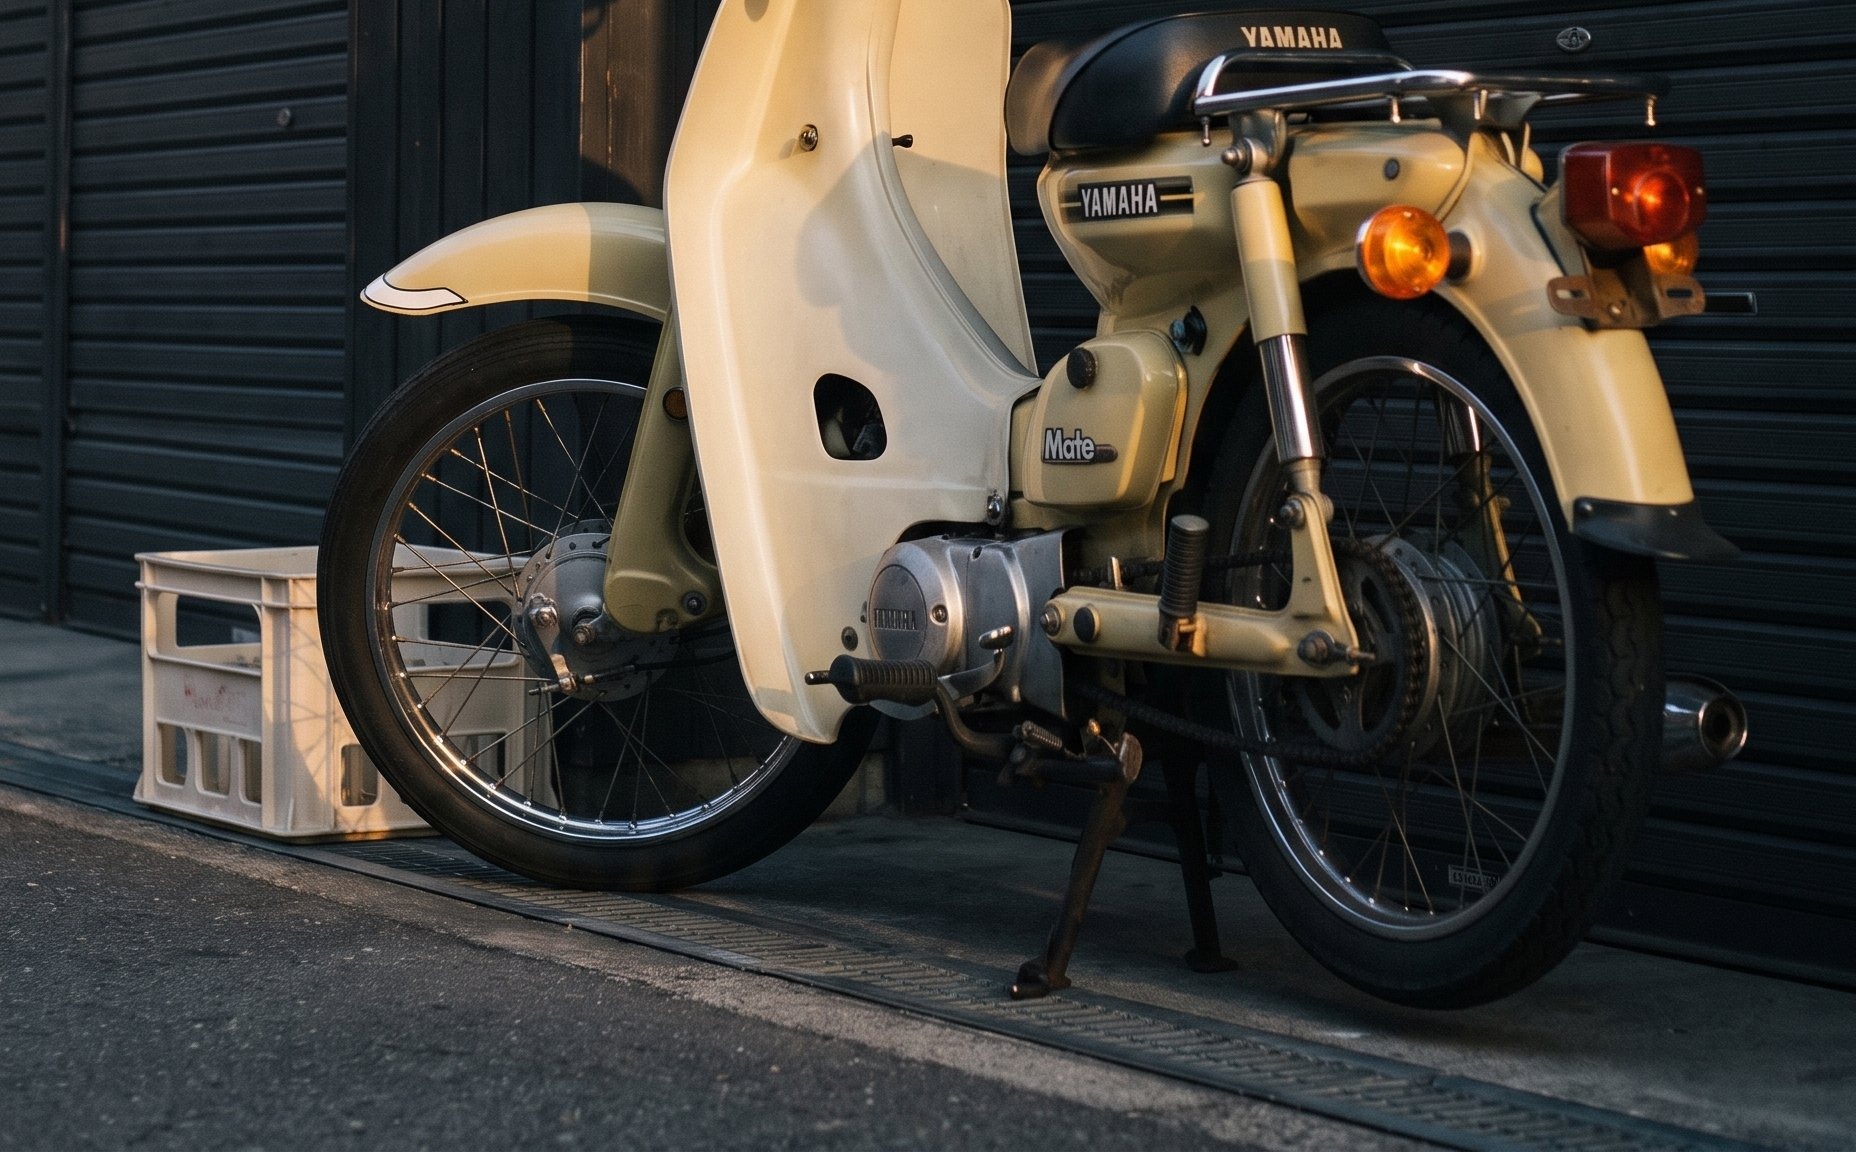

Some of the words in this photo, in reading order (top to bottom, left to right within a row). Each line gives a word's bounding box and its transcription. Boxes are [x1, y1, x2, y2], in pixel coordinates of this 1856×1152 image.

[1240, 25, 1344, 49] YAMAHA
[1080, 183, 1159, 218] YAMAHA
[1043, 428, 1096, 461] Mate
